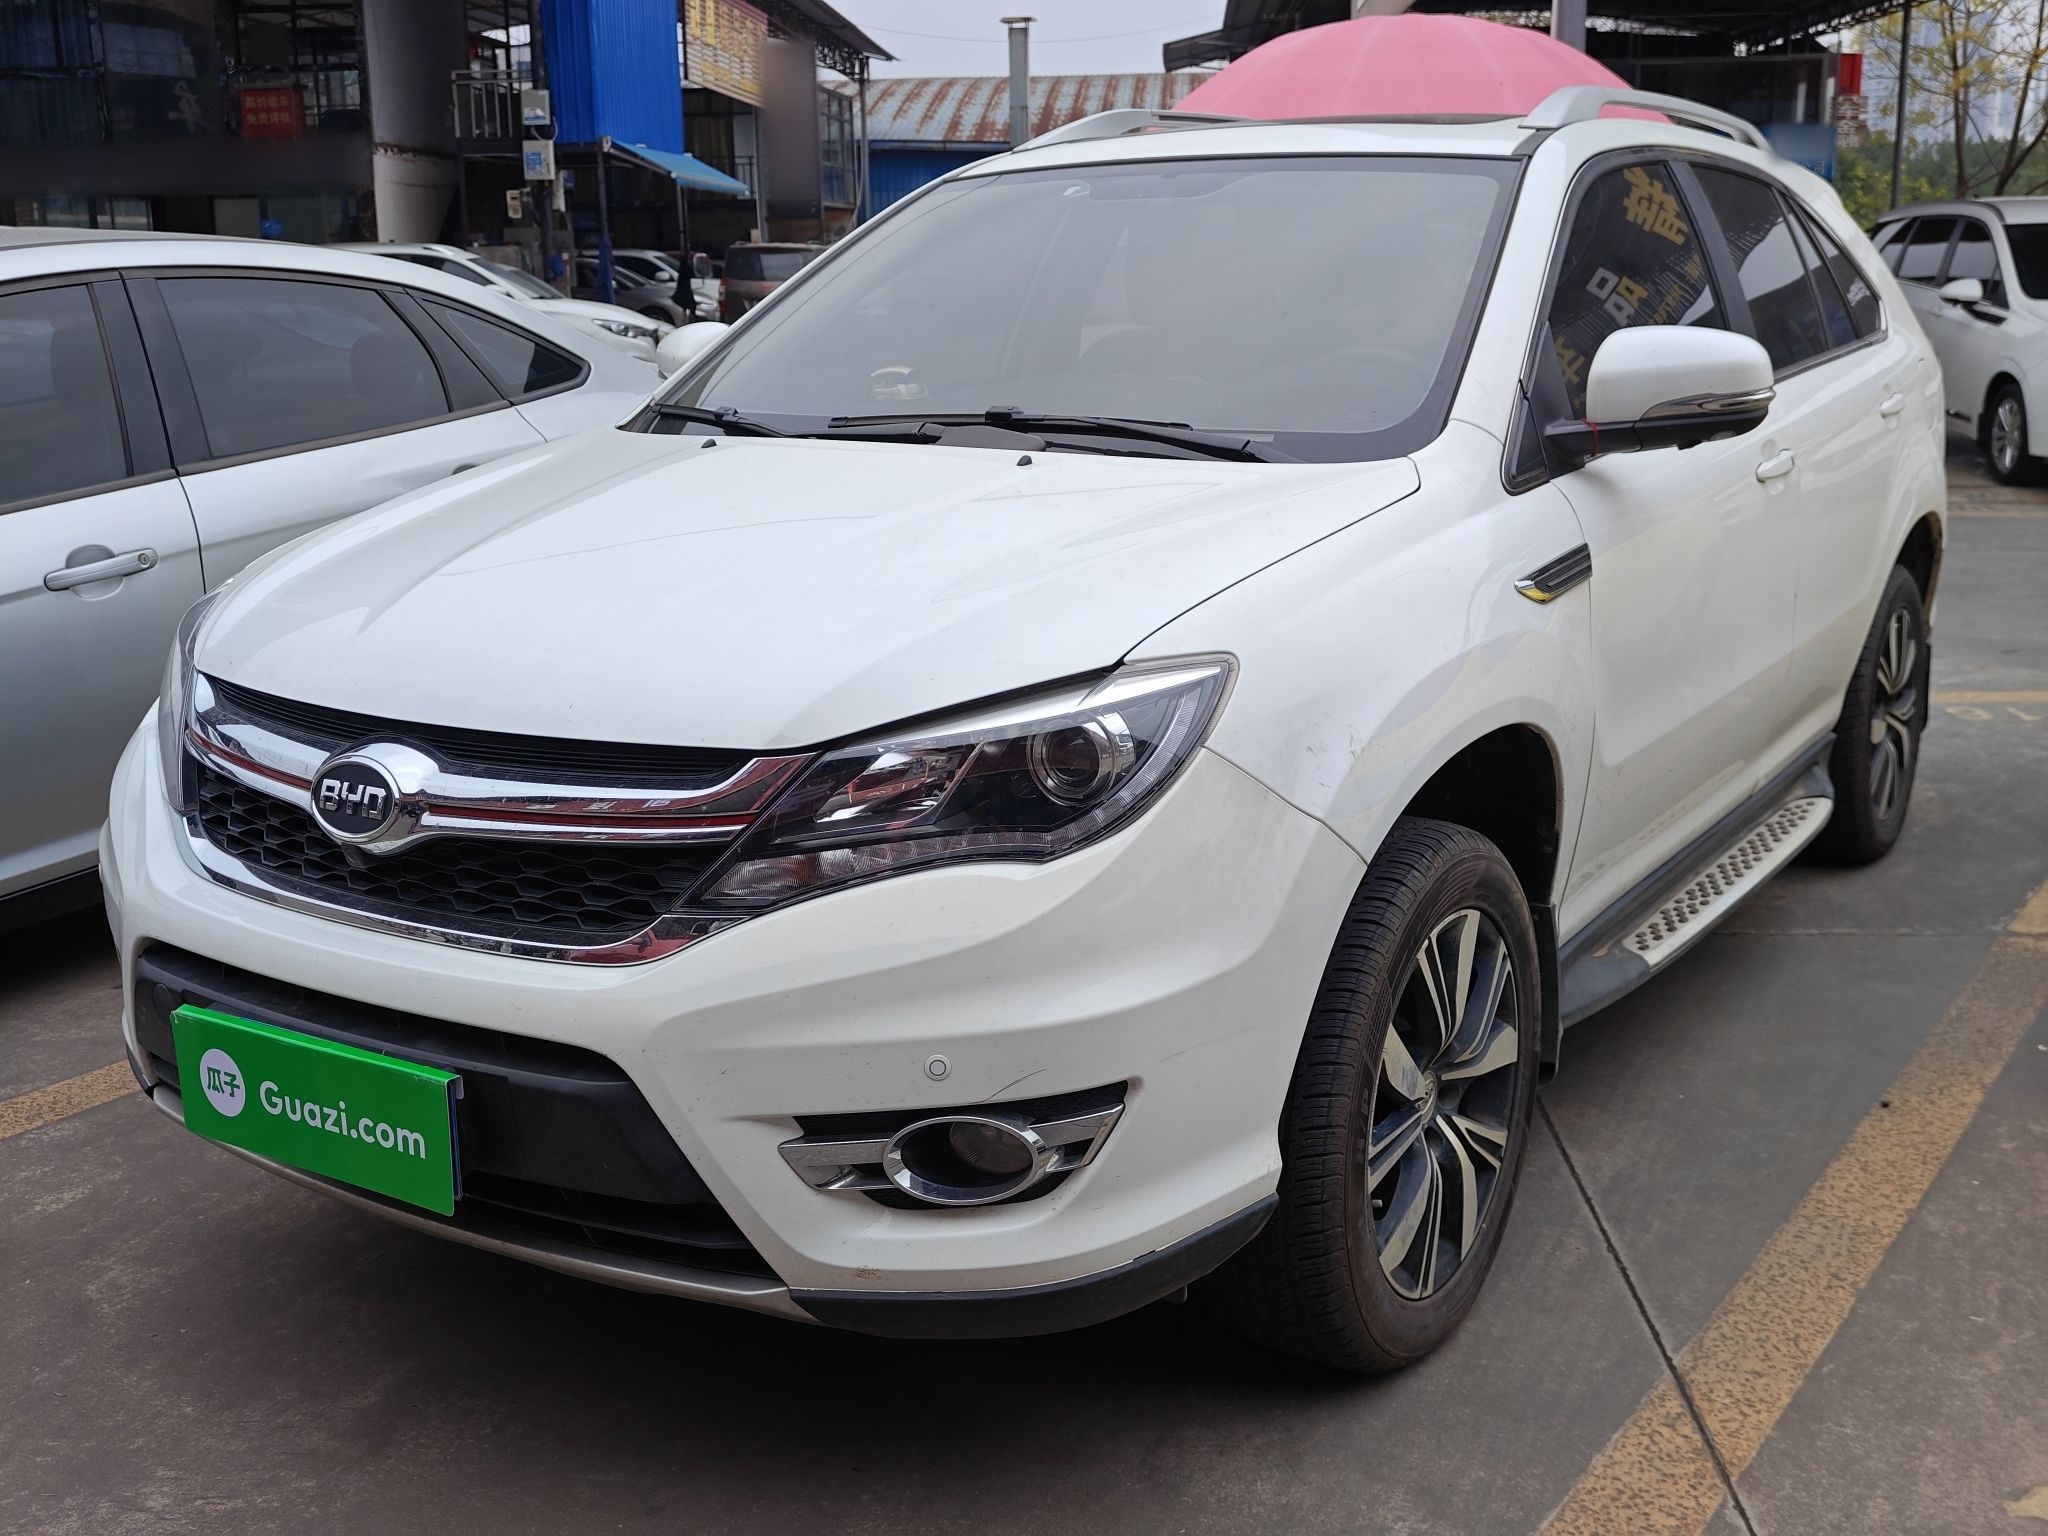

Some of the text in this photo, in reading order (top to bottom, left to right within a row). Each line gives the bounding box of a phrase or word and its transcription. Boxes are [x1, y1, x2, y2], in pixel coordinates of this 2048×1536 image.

[320, 779, 387, 820] BYD
[207, 1066, 240, 1098] 瓜子
[260, 1080, 427, 1159] Guazi.com
